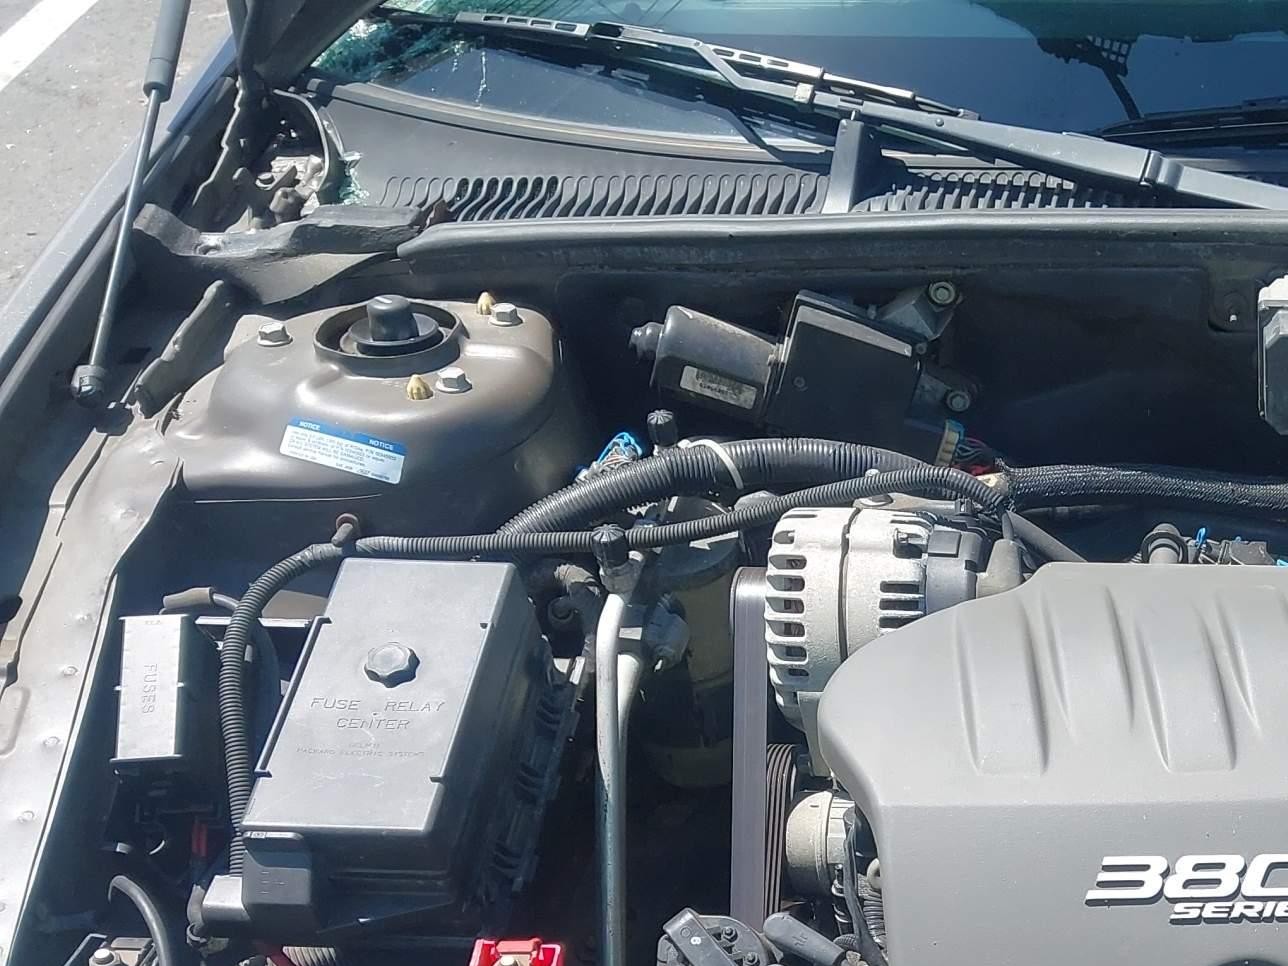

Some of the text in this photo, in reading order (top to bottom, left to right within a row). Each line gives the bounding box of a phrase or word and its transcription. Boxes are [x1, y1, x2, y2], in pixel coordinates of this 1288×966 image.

[368, 439, 394, 451] NOTICE
[142, 663, 158, 714] FUSES
[310, 697, 446, 712] FUSE RELAY
[336, 718, 411, 730] CENTER
[691, 936, 702, 945] 6
